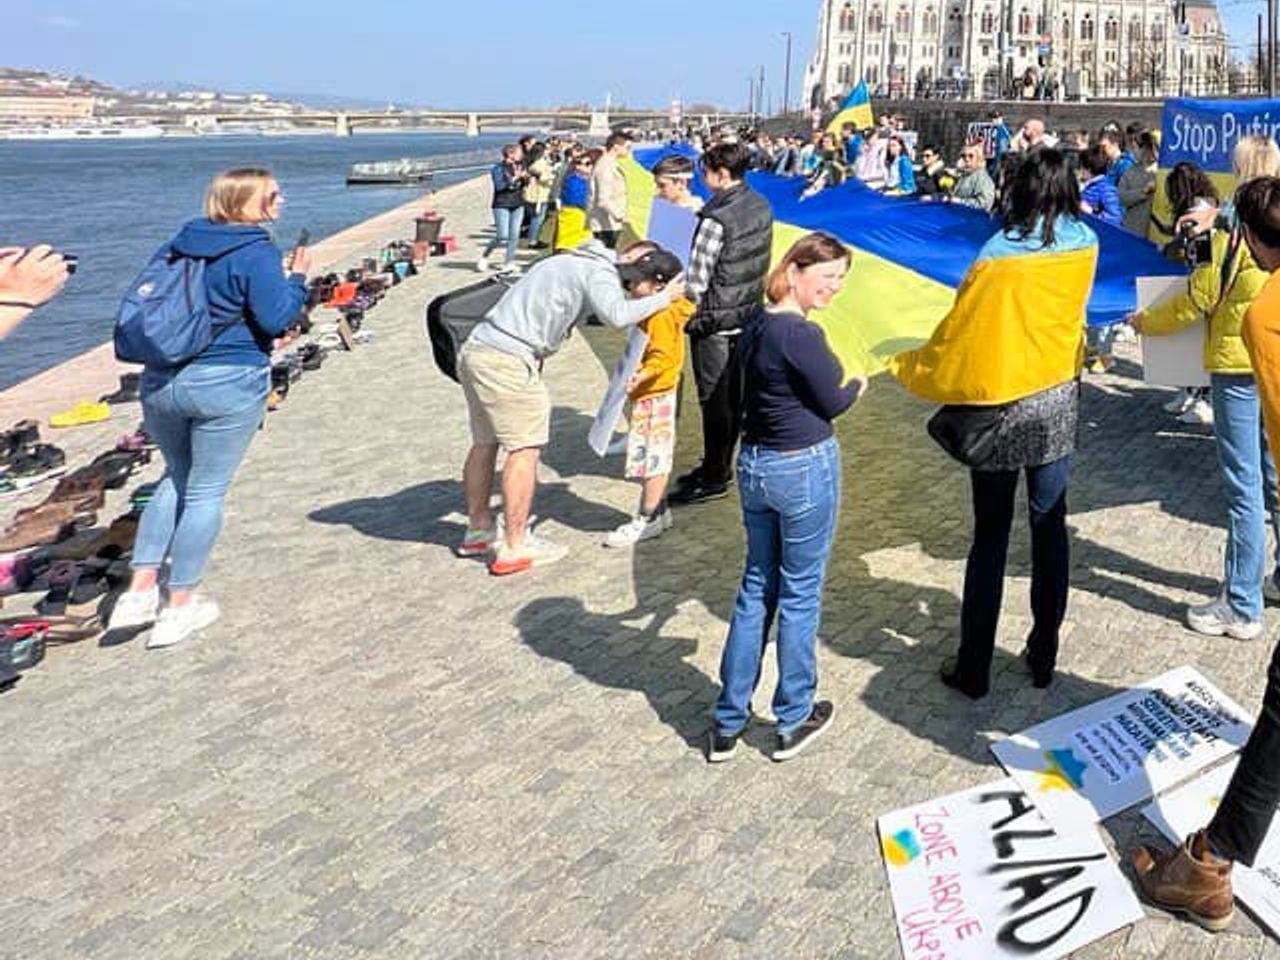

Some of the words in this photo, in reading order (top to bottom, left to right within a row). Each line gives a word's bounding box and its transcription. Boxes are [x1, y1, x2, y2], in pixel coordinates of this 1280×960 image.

[1168, 113, 1217, 162] Stop
[914, 806, 957, 865] ZONE
[929, 872, 982, 939] ABOVE
